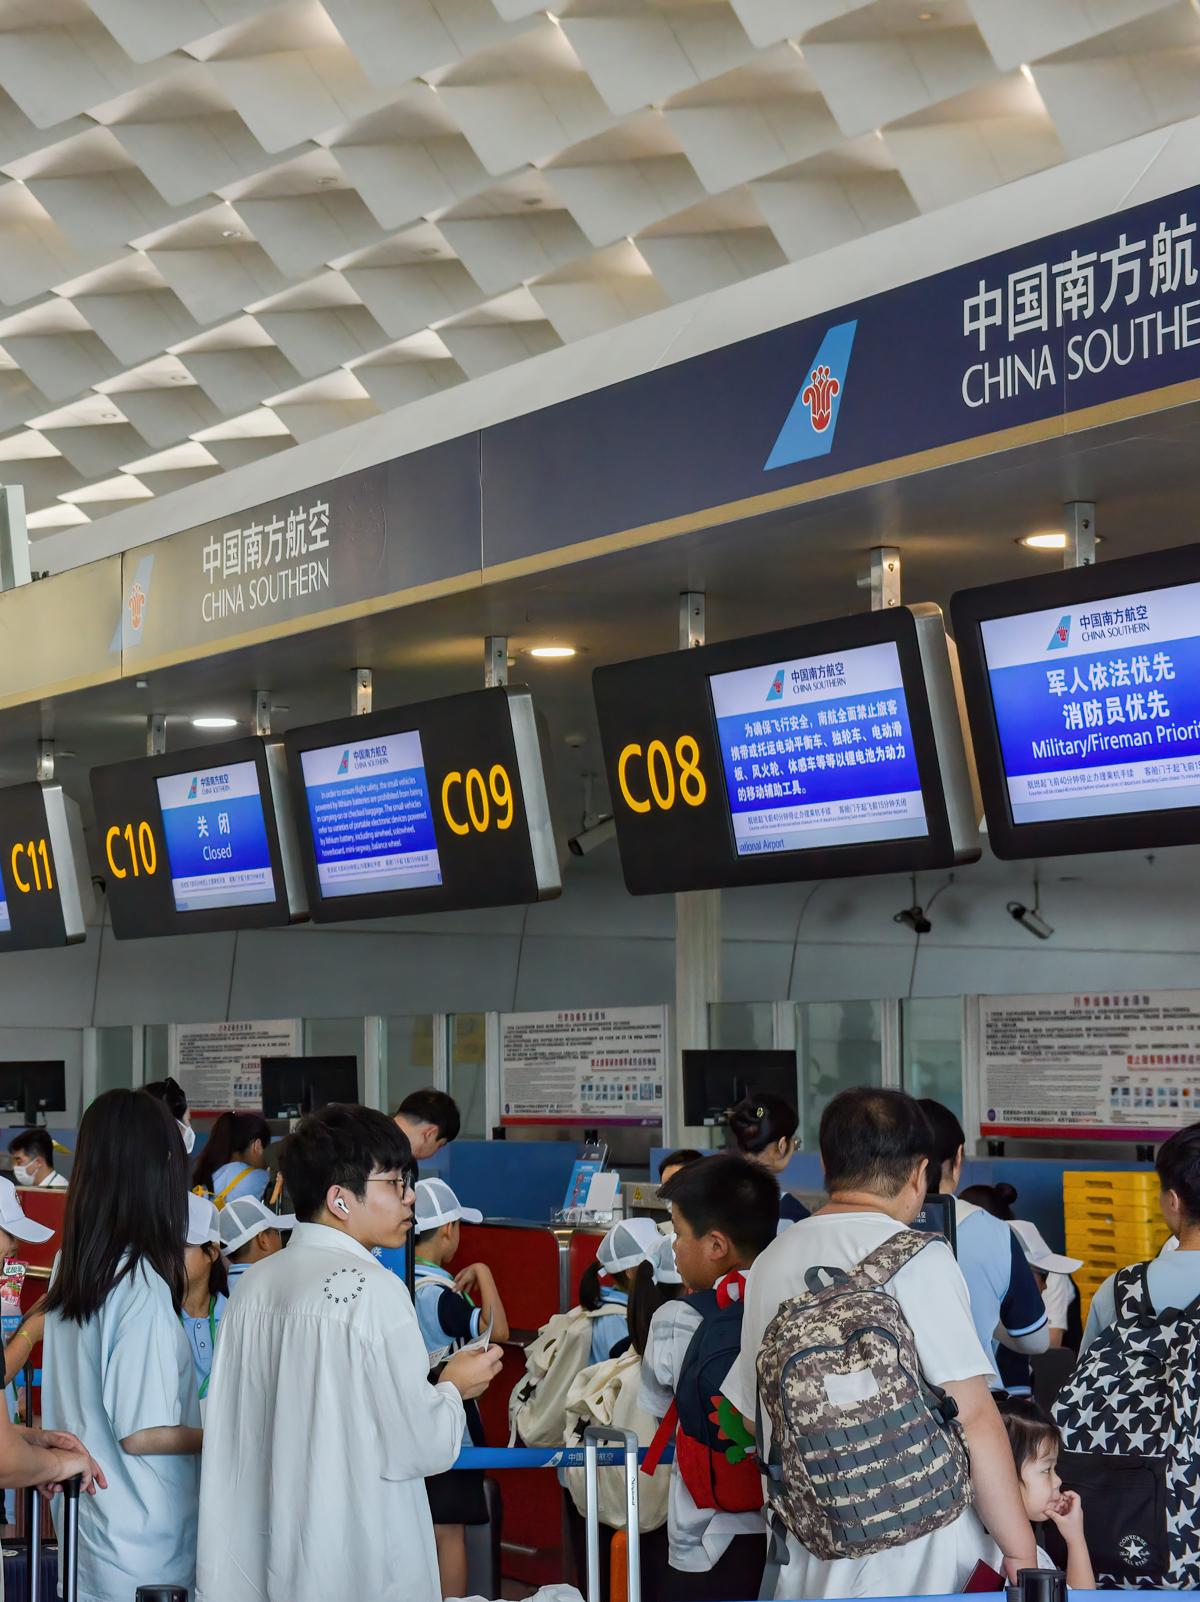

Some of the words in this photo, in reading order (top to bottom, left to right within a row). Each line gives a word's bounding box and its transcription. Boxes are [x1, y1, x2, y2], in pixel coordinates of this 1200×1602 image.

[963, 213, 1199, 351] 中国南方航
[961, 344, 1057, 408] CHINA
[1067, 299, 1200, 381] SOUTHE
[202, 500, 330, 584] 中国南方航空
[201, 584, 245, 622] CHINA
[249, 557, 330, 610] SOUTHERN
[1079, 605, 1149, 630] 中国南方航空
[1081, 627, 1106, 642] CHINA
[1107, 621, 1150, 638] SOUTHERN
[791, 661, 844, 683] 中国南方航空
[792, 680, 812, 695] CHINA
[813, 677, 847, 692] SOUTHERN
[1046, 651, 1176, 697] 军人依法优先
[1062, 689, 1171, 730] 消防员优先
[353, 745, 388, 761] 中国南方航空
[1031, 729, 1153, 760] Military/Fireman
[200, 773, 230, 787] 中国南方航空
[618, 734, 707, 814] C08
[441, 764, 514, 836] C09
[197, 812, 231, 839] 关闭
[106, 821, 157, 879] C10
[203, 842, 232, 861] Closed
[763, 838, 785, 851] Airport
[11, 839, 53, 893] C11
[1119, 1535, 1147, 1547] CONVERSE
